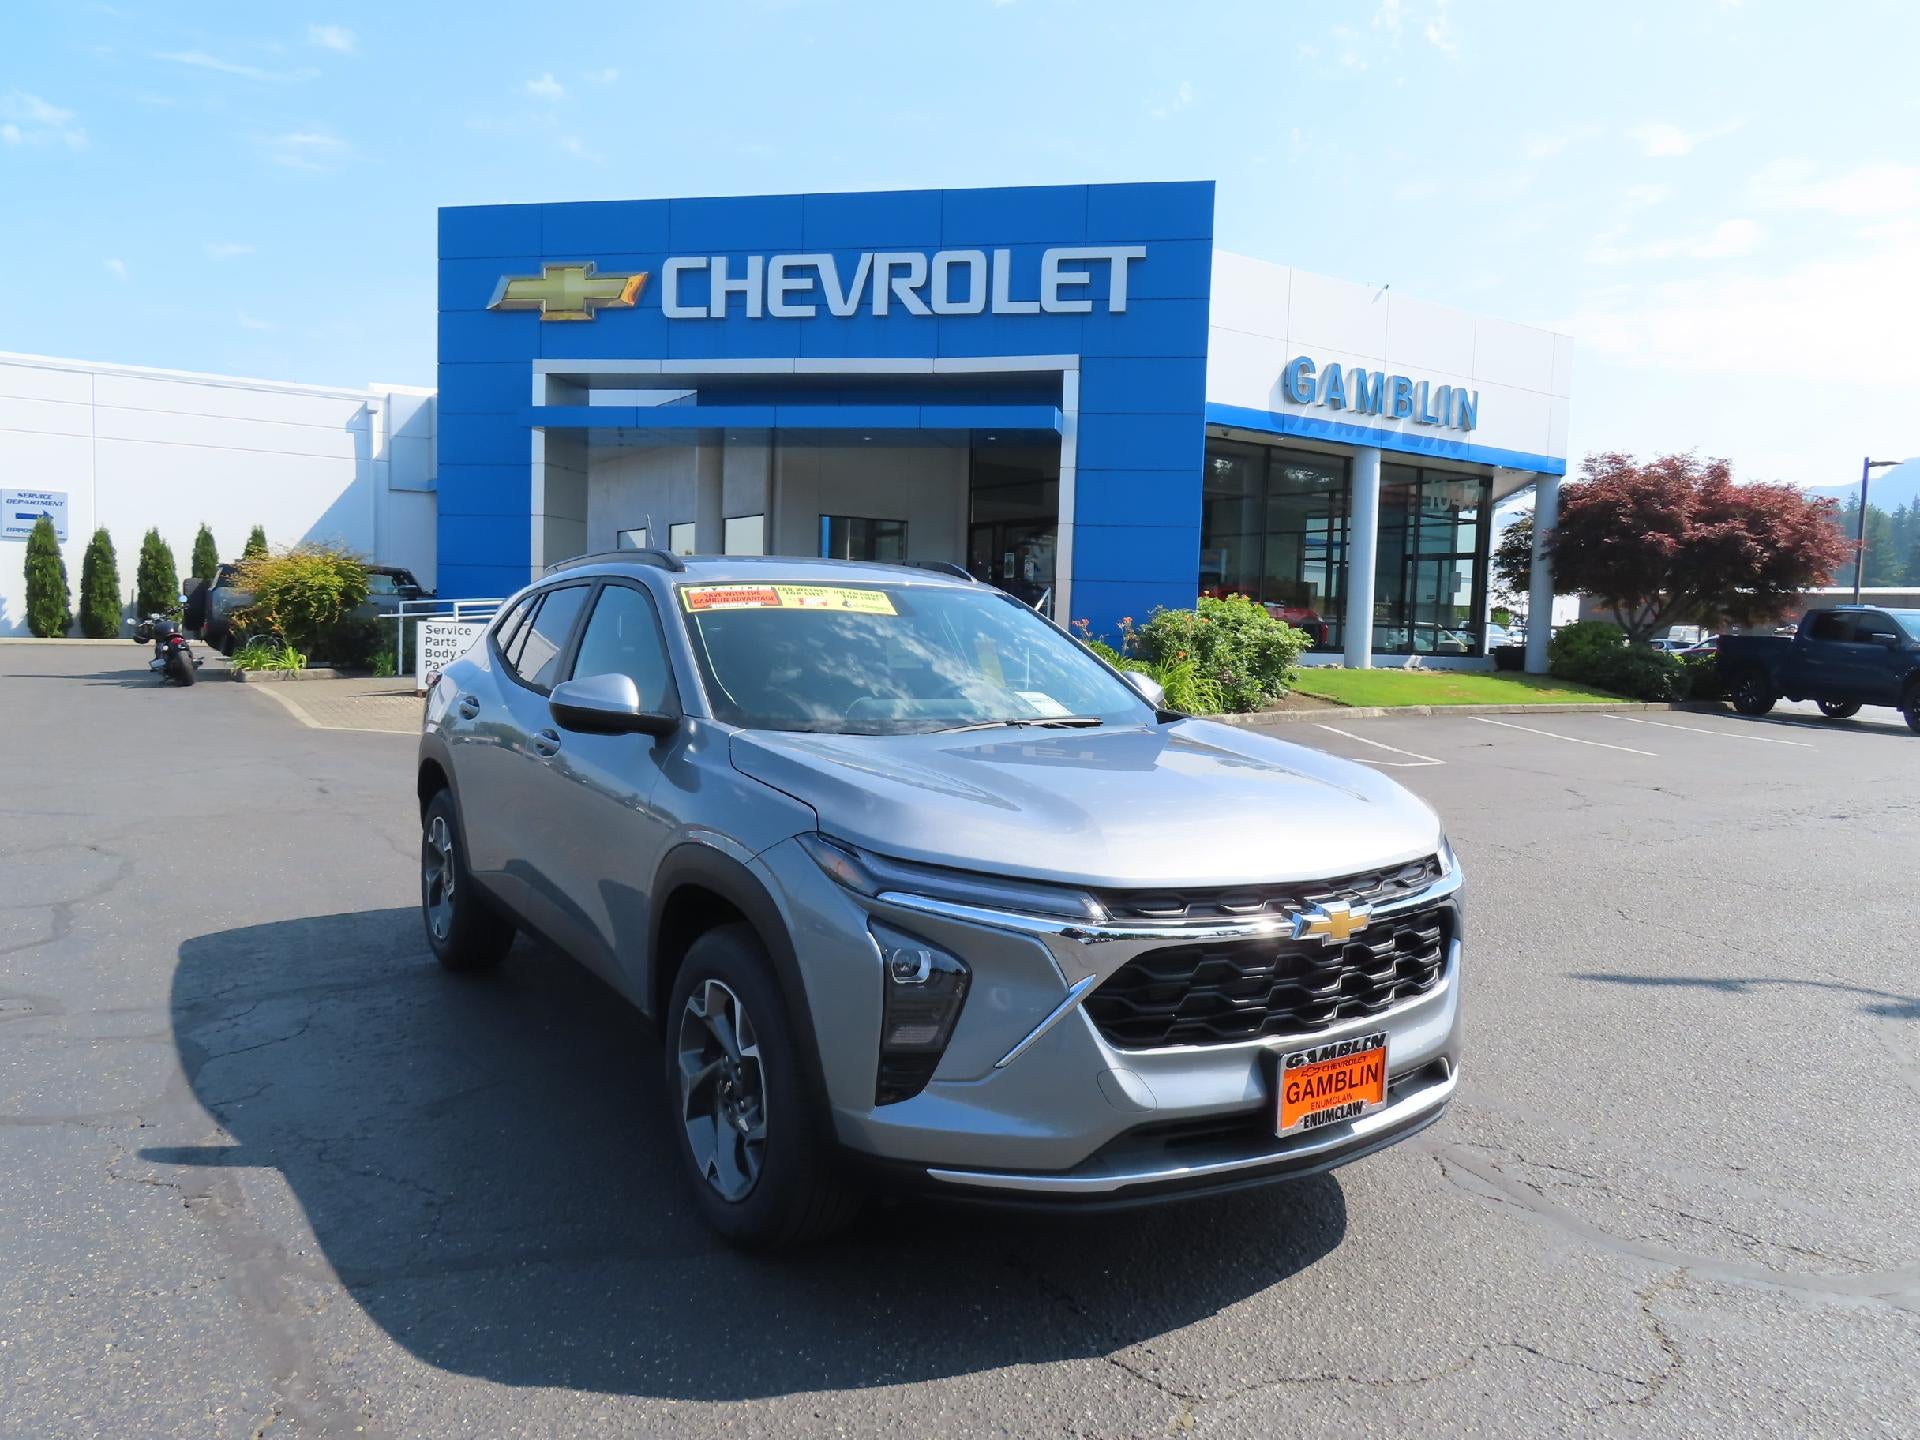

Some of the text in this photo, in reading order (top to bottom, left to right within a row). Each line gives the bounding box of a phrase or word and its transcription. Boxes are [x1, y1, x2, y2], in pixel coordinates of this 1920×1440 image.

[661, 245, 1147, 319] CHEVROLET
[1284, 355, 1479, 432] GAMBLIN
[6, 498, 65, 507] DEPARTMENT
[425, 624, 472, 636] Service
[425, 636, 457, 647] Parts
[425, 648, 457, 662] Body
[1286, 1033, 1387, 1069] GAMBLIN
[1321, 1056, 1367, 1072] CHEVROLET
[1286, 1062, 1379, 1105] GAMBLIN
[1310, 1092, 1353, 1110] ENUMCLAW
[1303, 1100, 1364, 1129] ENUMCLAW
